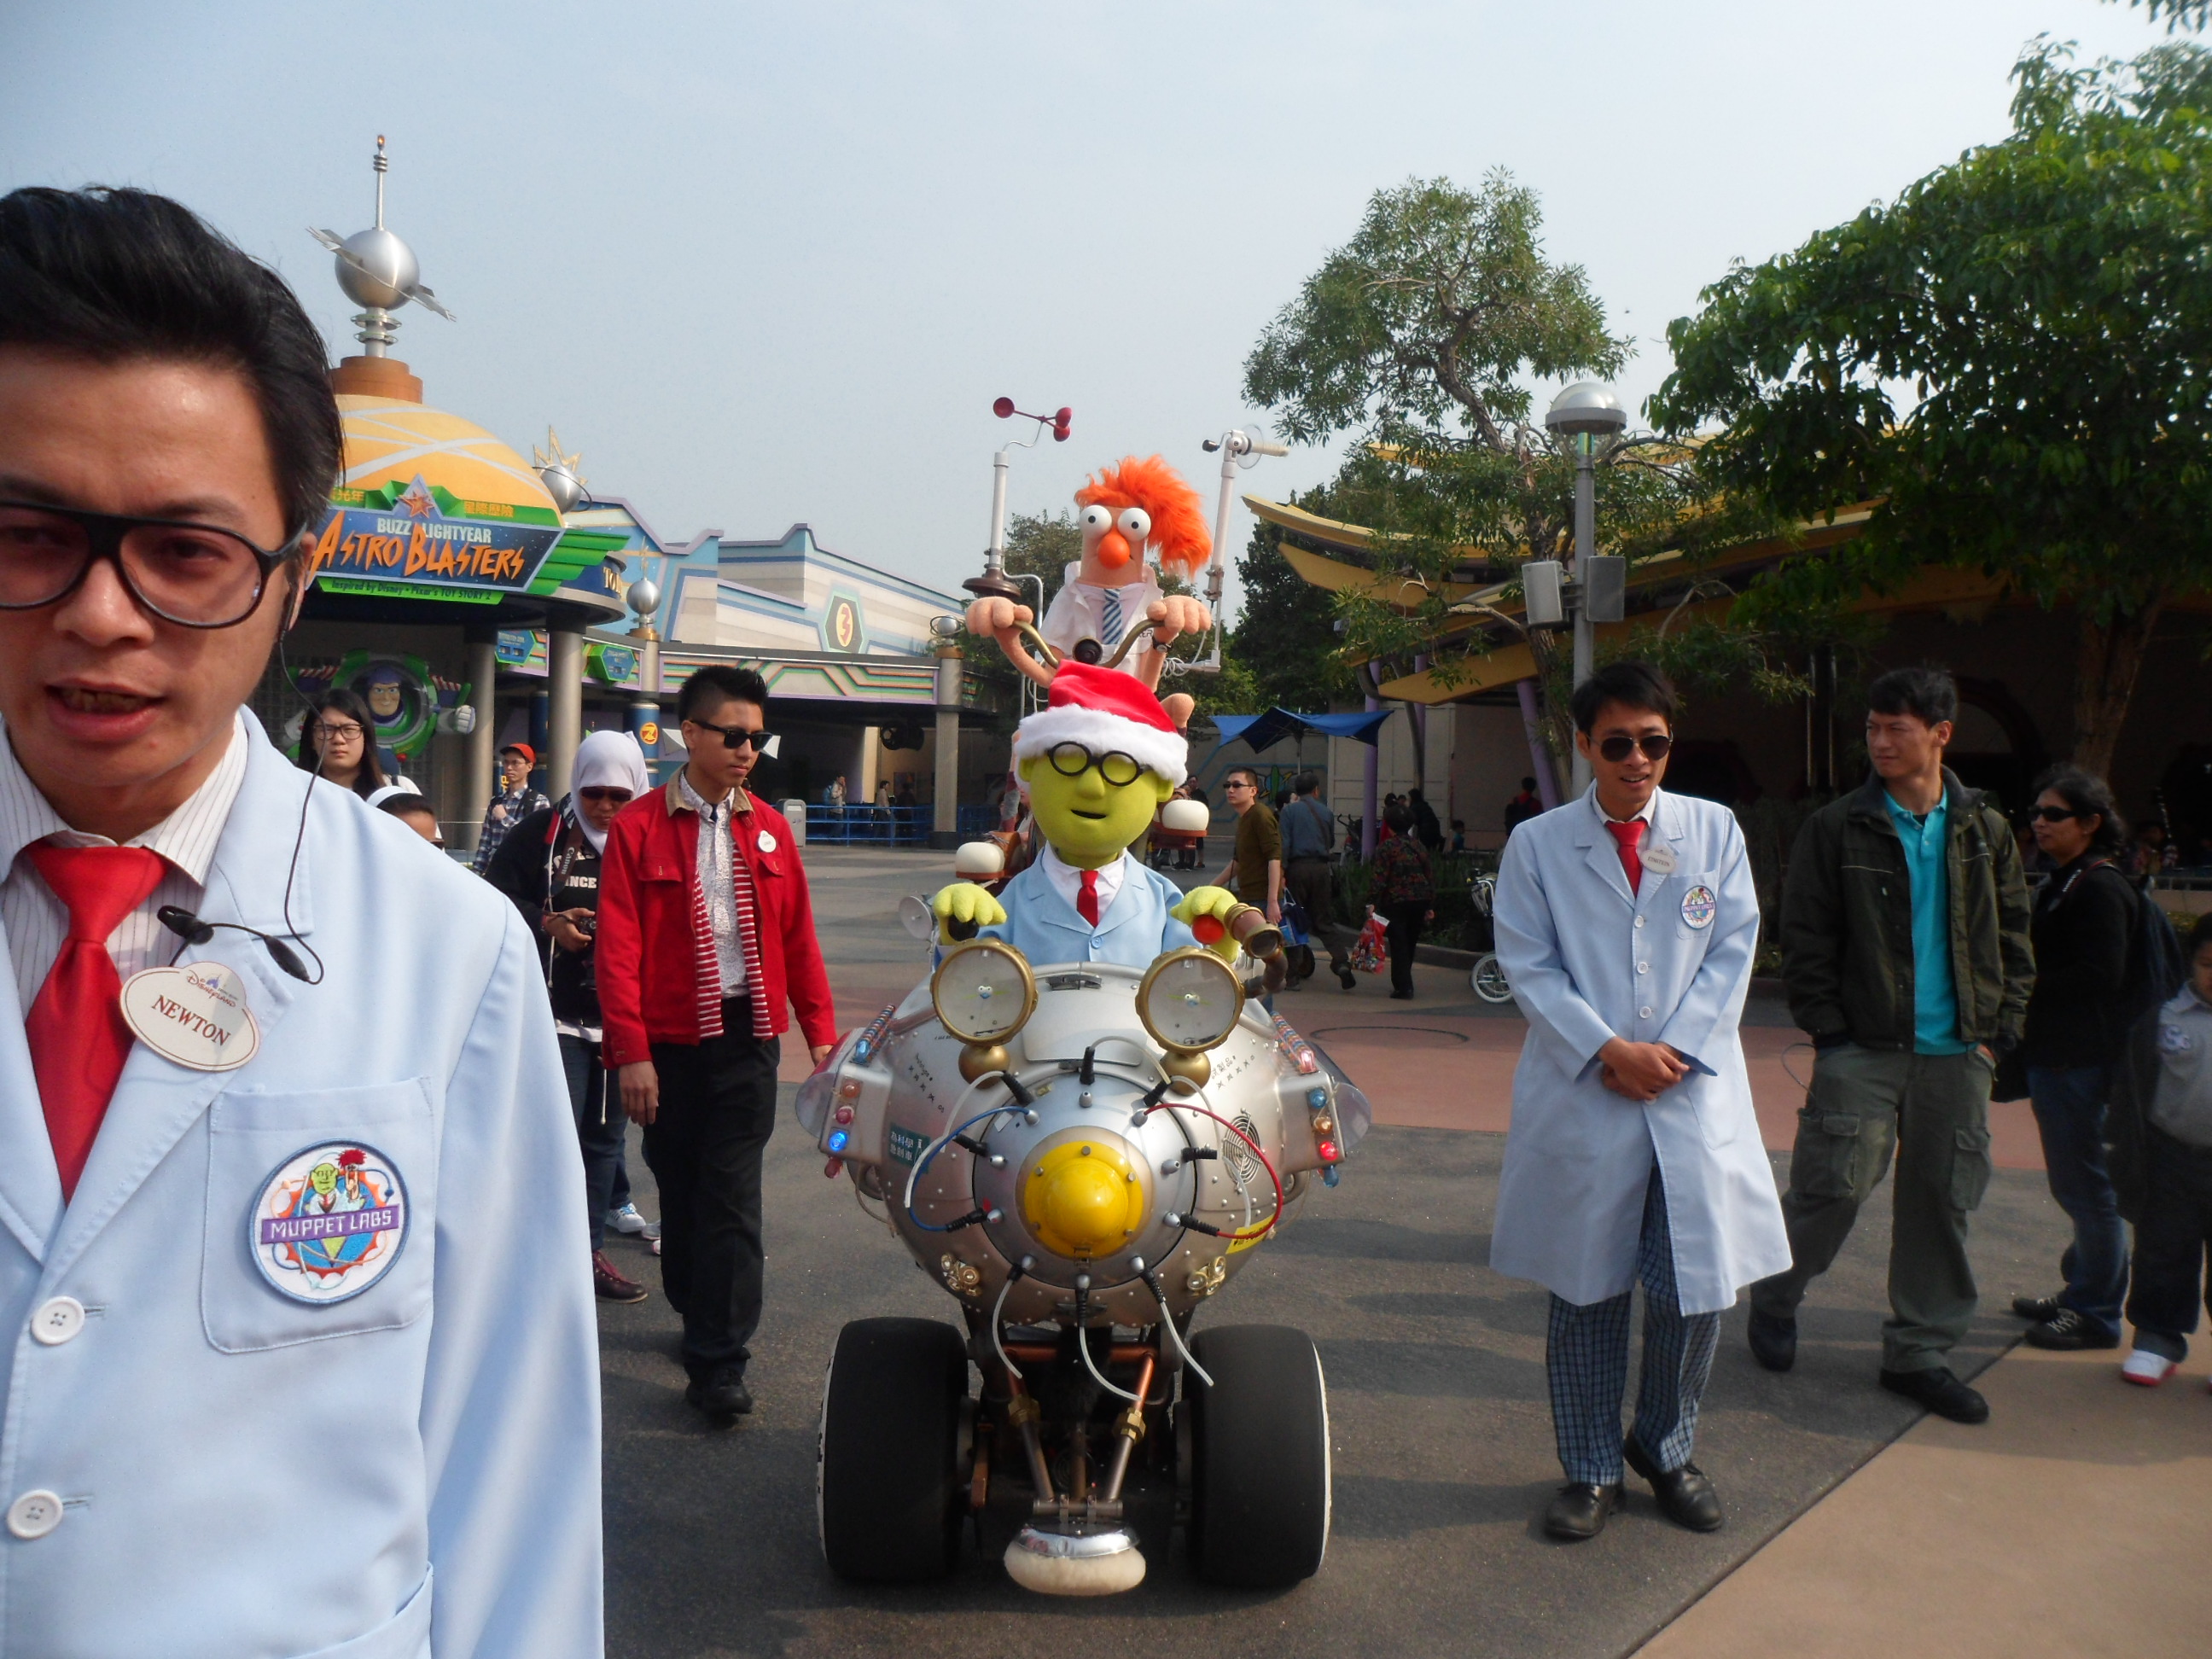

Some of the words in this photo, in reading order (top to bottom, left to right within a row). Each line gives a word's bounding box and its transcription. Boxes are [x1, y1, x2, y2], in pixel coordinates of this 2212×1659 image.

[377, 517, 412, 536] BUZZ
[421, 522, 492, 544] LIGHTYEAR
[309, 510, 405, 584] ASTRO
[404, 522, 526, 581] BLASTERS
[441, 586, 457, 597] TOY
[458, 588, 483, 600] STORY
[561, 847, 575, 875] Canon
[152, 994, 231, 1047] NEWTON
[271, 1215, 346, 1239] MUPPET
[350, 1210, 393, 1231] LABS
